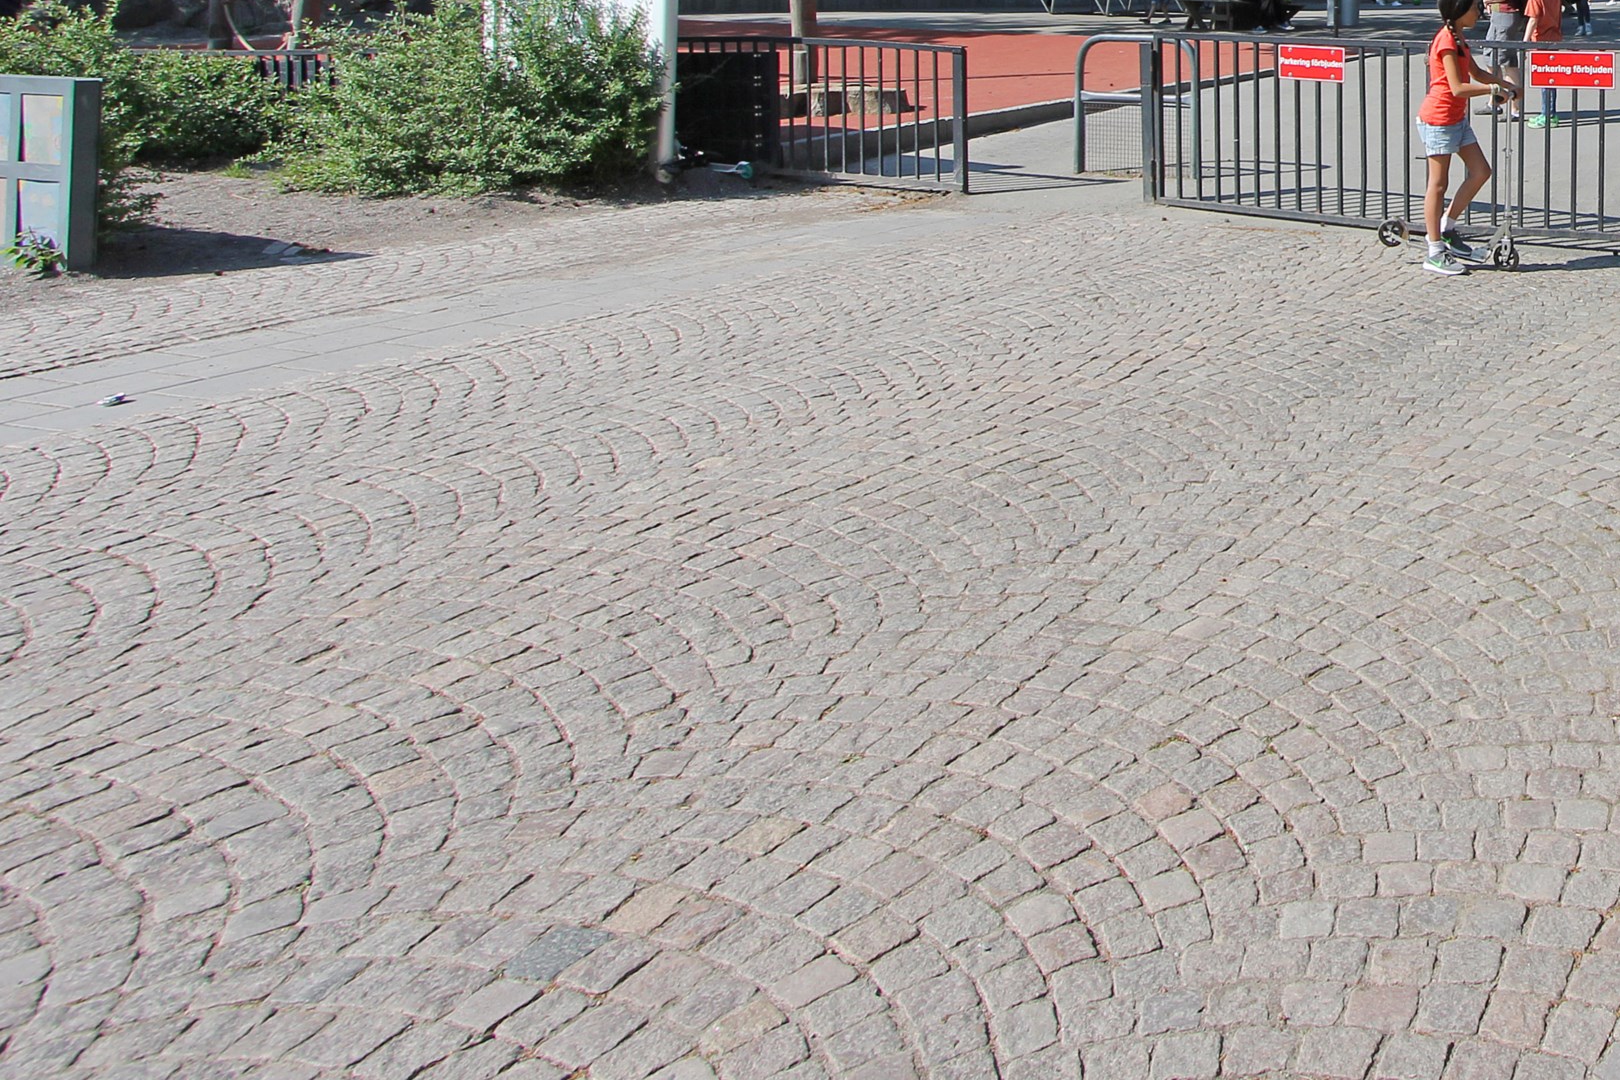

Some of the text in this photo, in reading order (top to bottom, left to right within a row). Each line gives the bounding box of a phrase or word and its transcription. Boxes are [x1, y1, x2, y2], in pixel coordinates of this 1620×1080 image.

[1279, 56, 1343, 69] Parkering förbjuden
[1531, 64, 1613, 76] Parkering förbjuden
